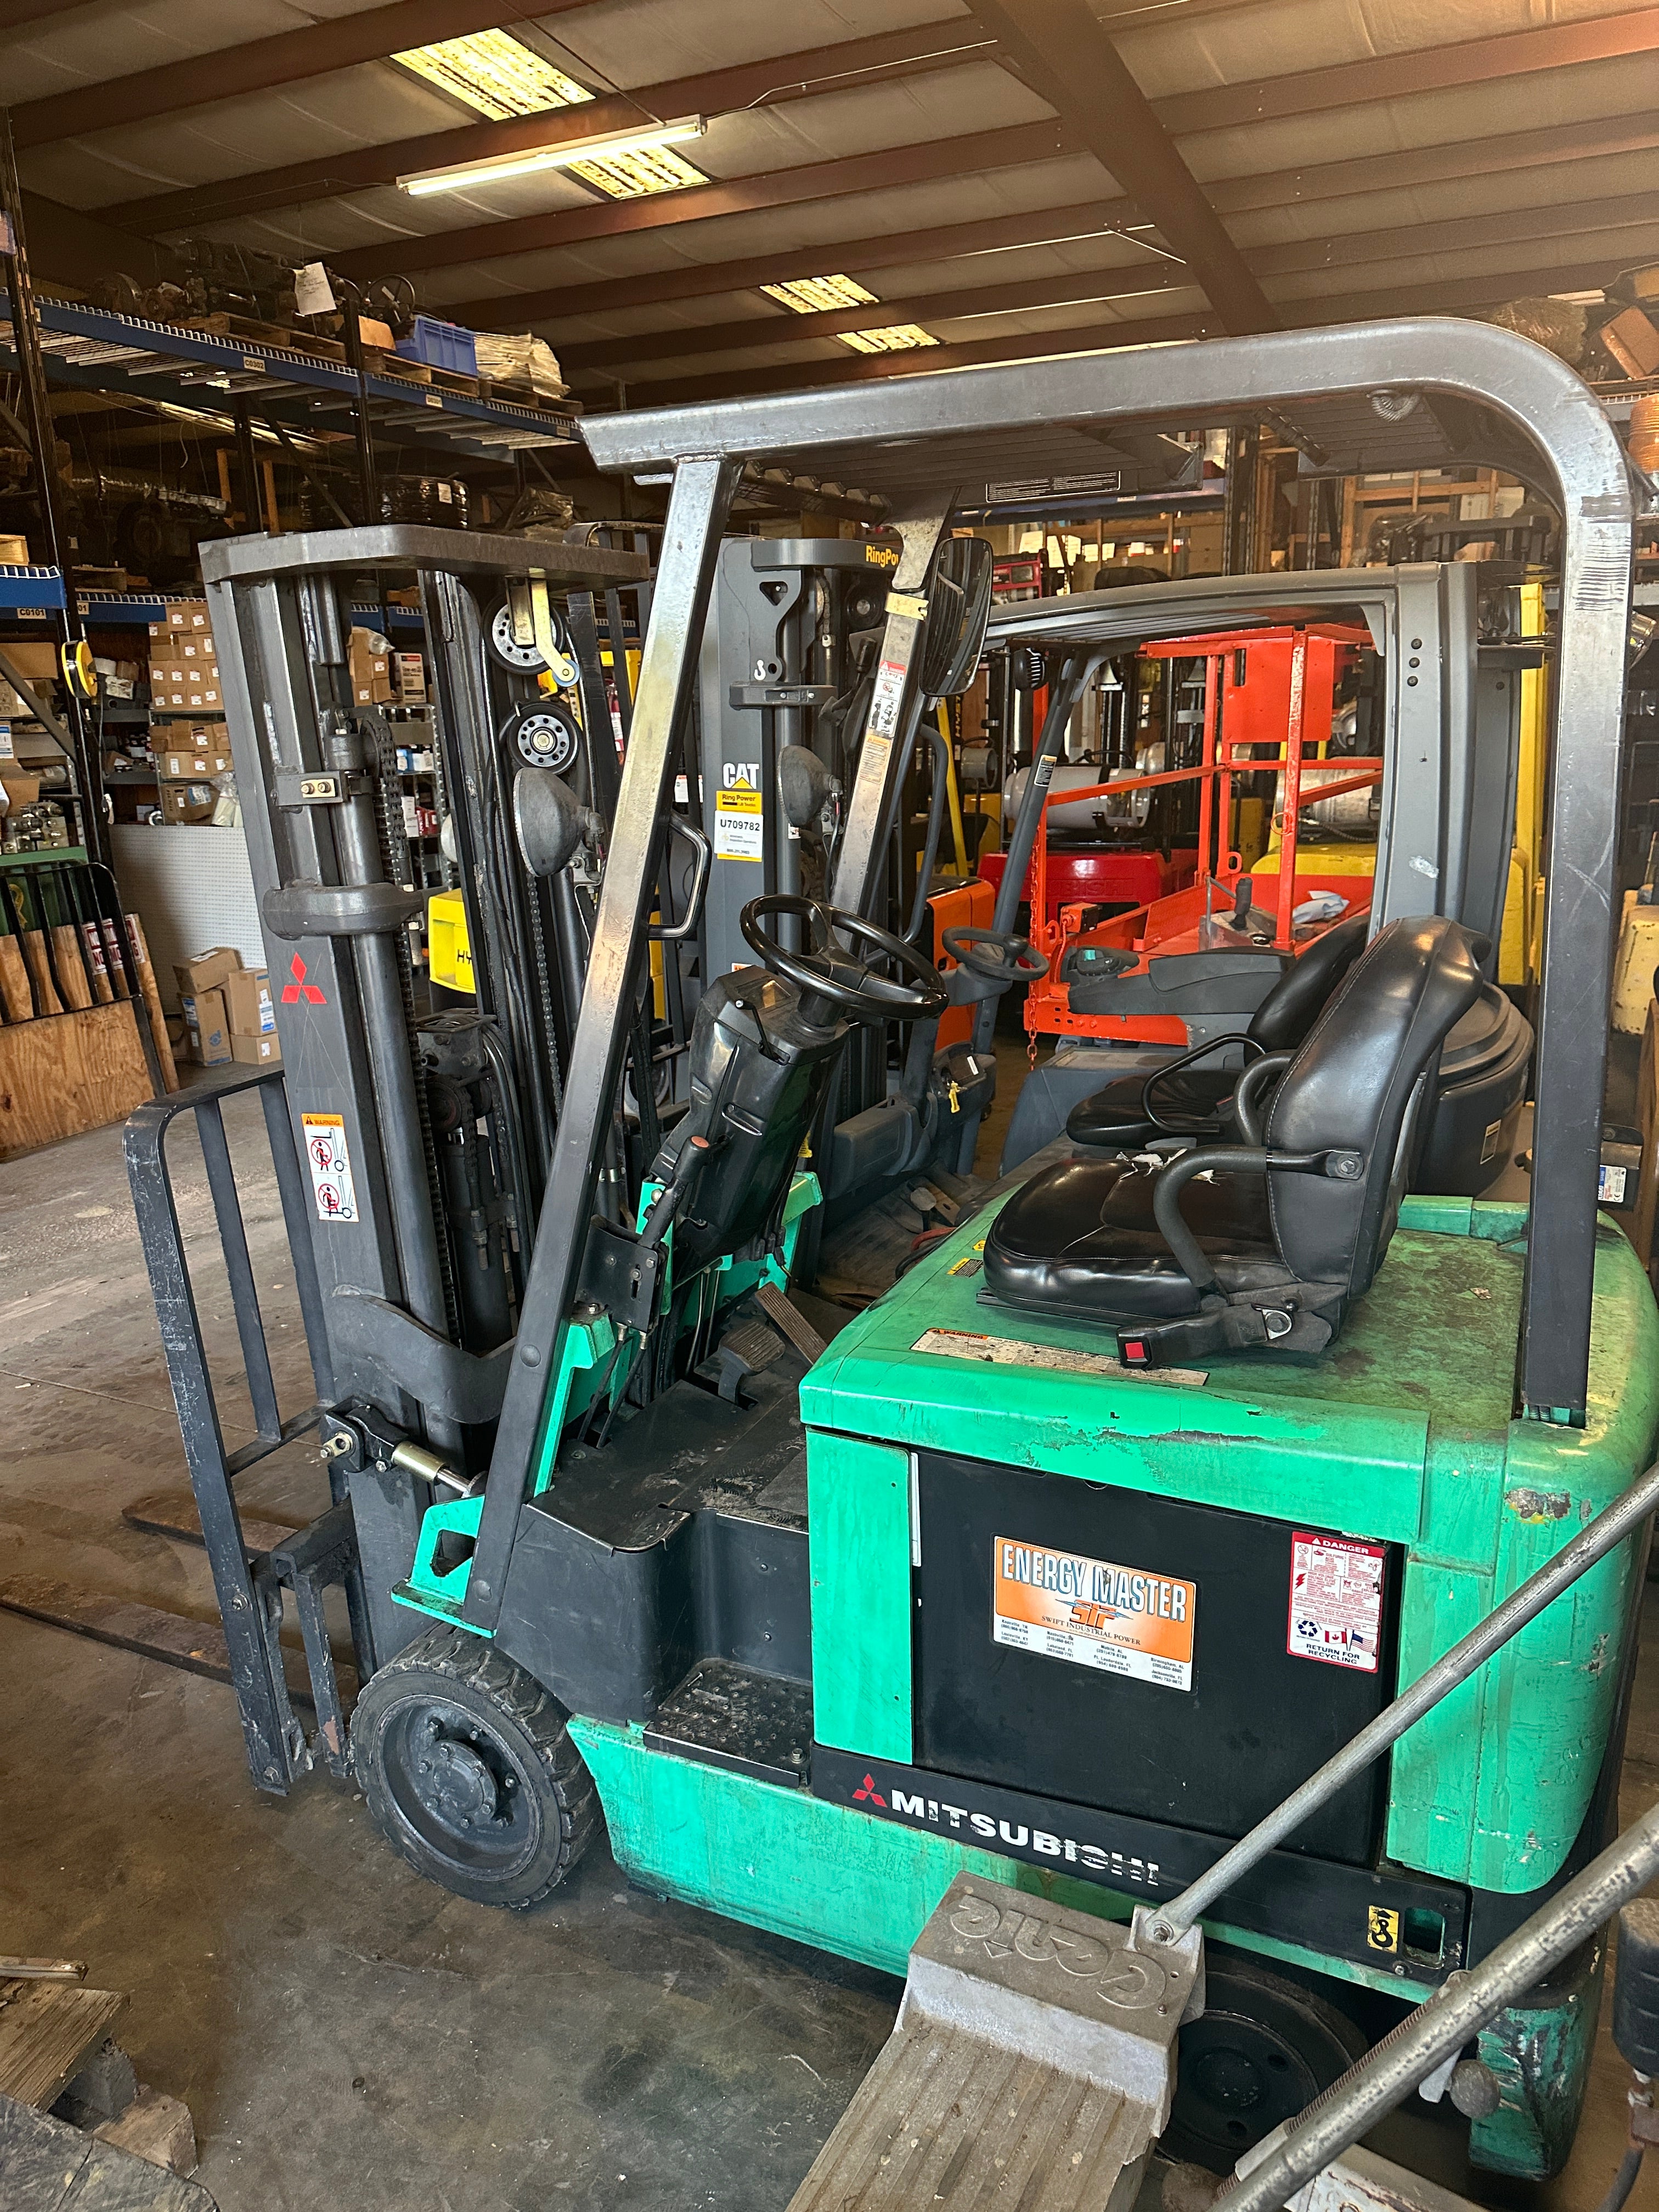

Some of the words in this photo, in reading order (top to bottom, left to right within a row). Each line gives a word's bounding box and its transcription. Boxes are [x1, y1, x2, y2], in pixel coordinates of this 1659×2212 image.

[866, 545, 899, 568] RingPo
[723, 763, 759, 789] CAT
[720, 819, 760, 831] U709782
[944, 1330, 983, 1339] WARNING
[1322, 1540, 1369, 1555] DANGER
[1002, 1543, 1087, 1597] ENERGY
[1092, 1565, 1187, 1622] MASTER
[1041, 1615, 1065, 1627] SWIFT
[1066, 1621, 1113, 1639] INDUSTRIAL
[1114, 1633, 1141, 1646] POWER
[1306, 1643, 1340, 1655] RETURN
[1342, 1651, 1360, 1660] FOR
[1308, 1649, 1357, 1664] RECYCLING
[891, 1788, 1159, 1886] MITSUBISHI
[950, 1894, 1167, 2009] Genie
